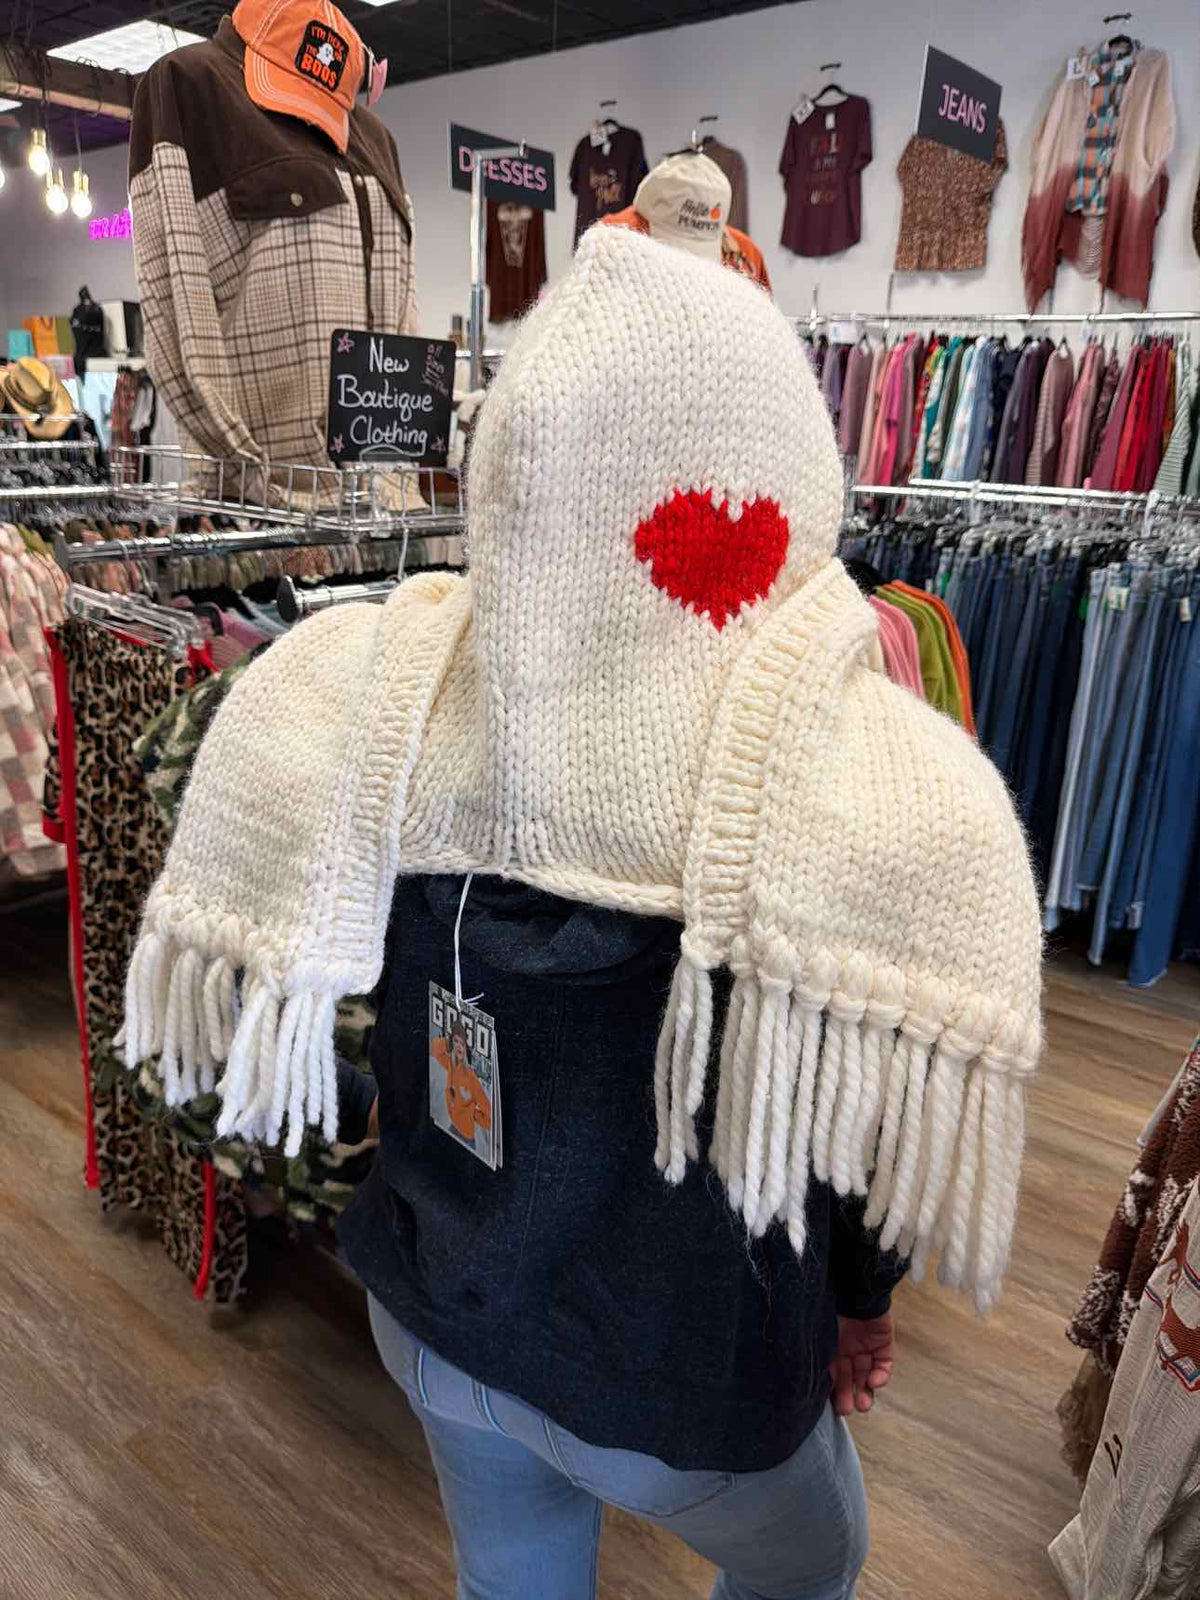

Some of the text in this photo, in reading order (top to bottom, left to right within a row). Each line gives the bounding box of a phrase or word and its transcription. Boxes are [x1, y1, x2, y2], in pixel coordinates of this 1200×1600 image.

[301, 53, 337, 88] BOOS
[938, 83, 987, 134] JEANS
[459, 146, 548, 192] DESSES
[369, 337, 410, 373] New
[337, 374, 434, 422] Boutique
[350, 415, 428, 456] Clothing
